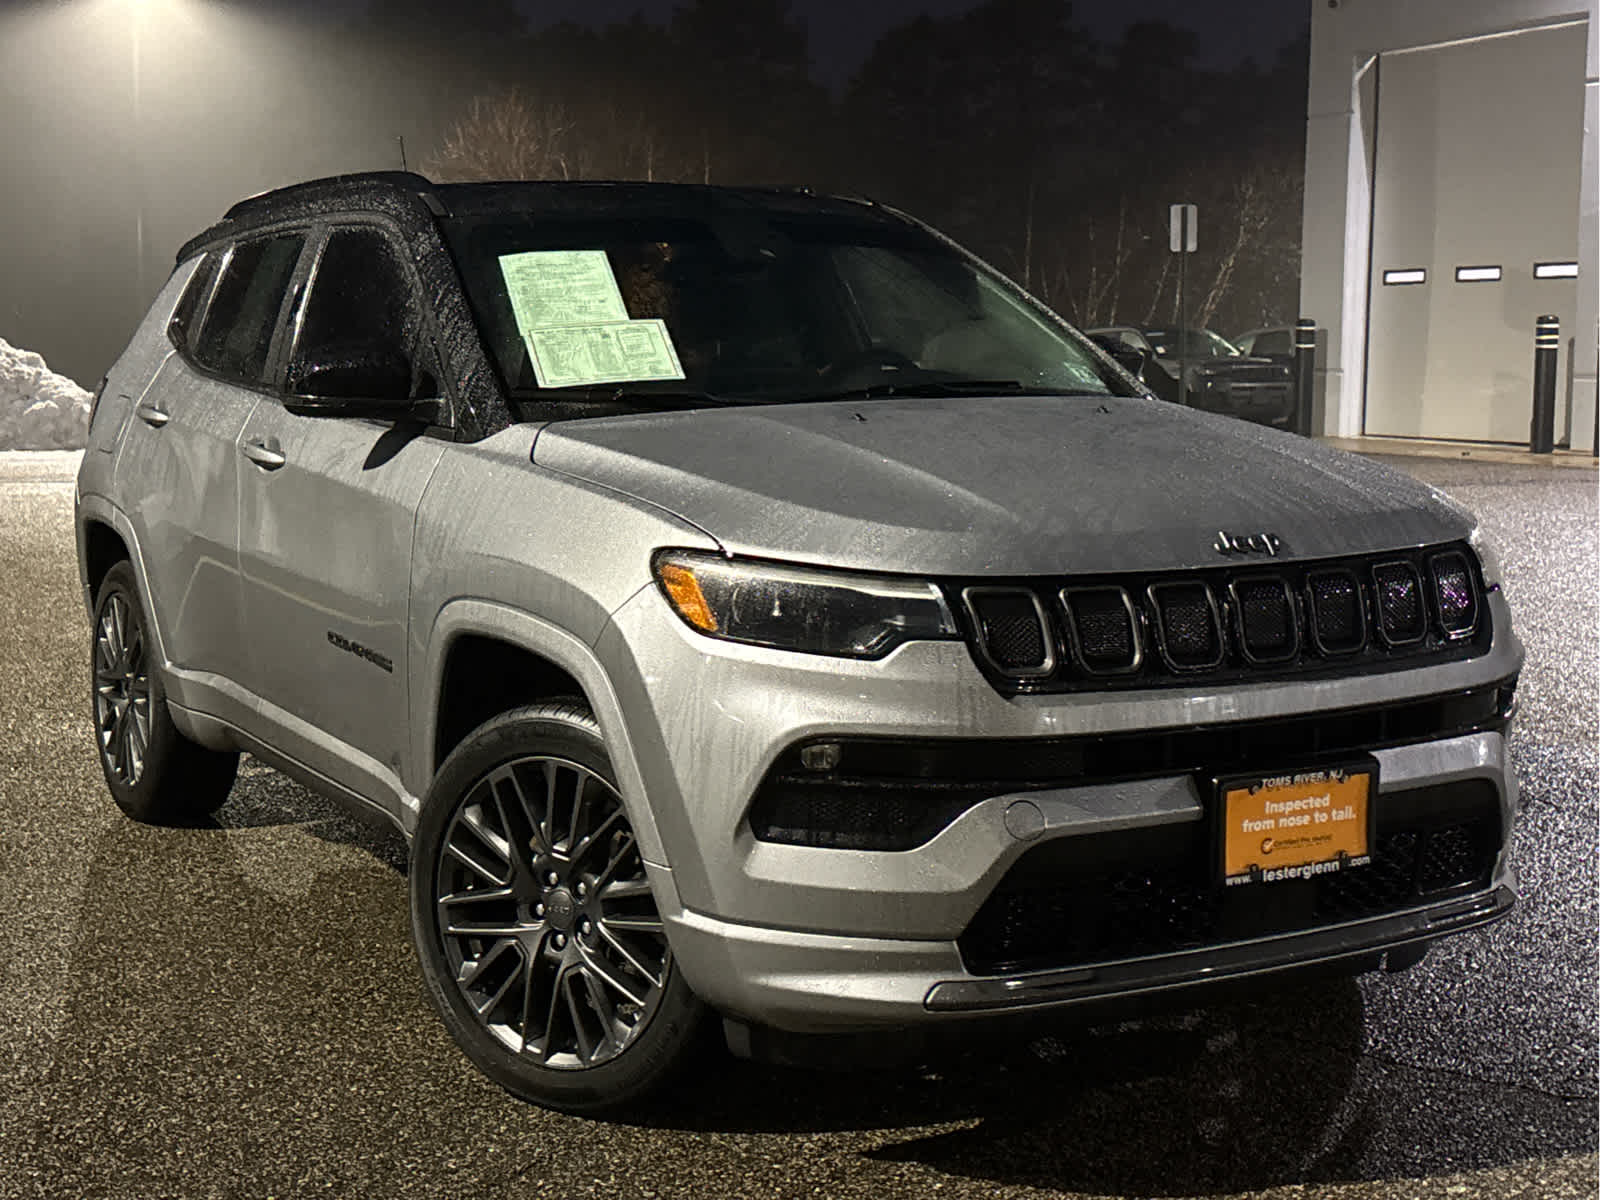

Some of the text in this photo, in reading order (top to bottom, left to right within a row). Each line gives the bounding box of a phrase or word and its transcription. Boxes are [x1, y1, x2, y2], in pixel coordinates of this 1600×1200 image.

[1212, 530, 1281, 557] Jeep
[1261, 775, 1291, 788] TOMS
[1328, 769, 1344, 780] NJ
[1265, 794, 1331, 815] Inspected
[1241, 806, 1356, 833] from nose to tail.
[1262, 859, 1340, 883] lesterglenn
